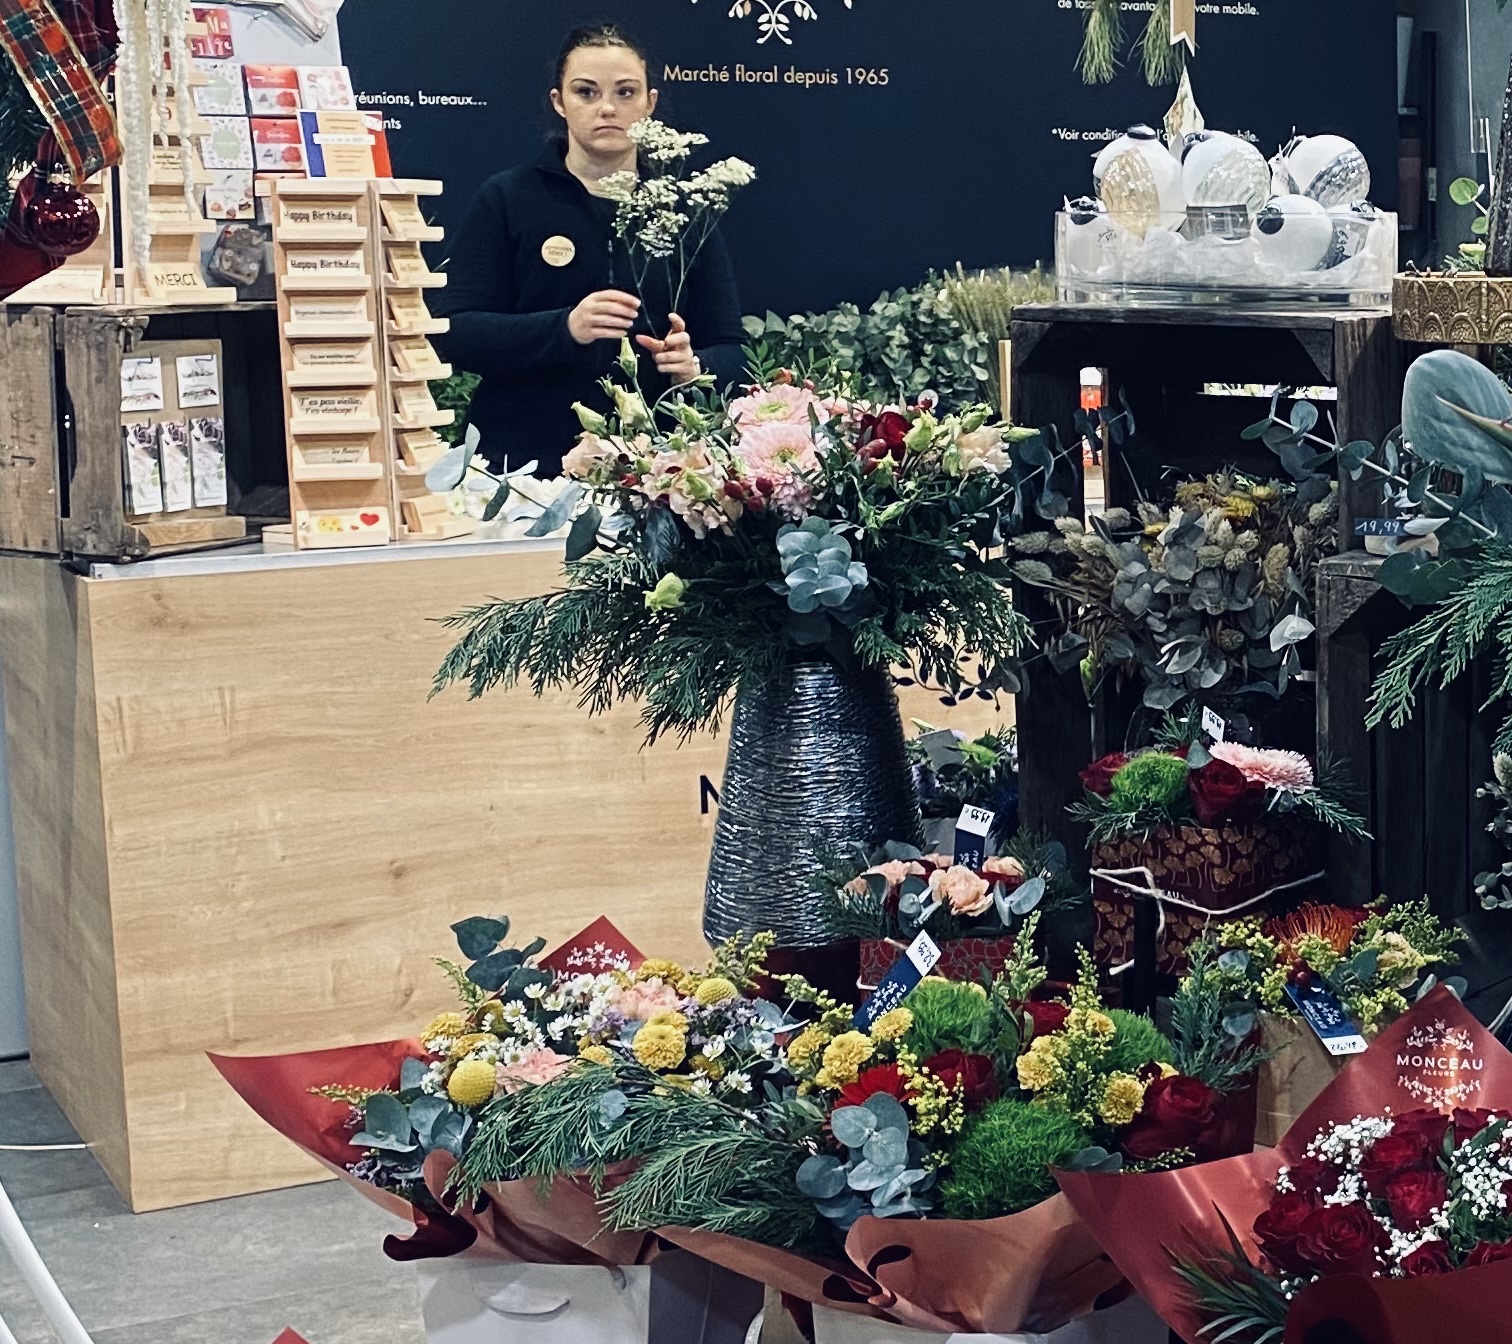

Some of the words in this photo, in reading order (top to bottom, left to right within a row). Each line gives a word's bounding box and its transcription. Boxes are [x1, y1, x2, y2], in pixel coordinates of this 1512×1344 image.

[1195, 3, 1220, 15] votre
[1222, 2, 1260, 16] mobile.
[663, 64, 730, 84] Marché
[735, 64, 779, 85] floral
[783, 66, 838, 88] depuis
[845, 67, 890, 87] 1965
[355, 91, 415, 108] réunions,
[418, 90, 488, 107] bureaux...
[283, 210, 310, 223] Happy
[312, 209, 353, 223] Birthday
[290, 259, 317, 271] Happy
[320, 258, 361, 271] Birthday
[154, 272, 198, 287] MERCI
[1355, 519, 1400, 535] 19,99
[1396, 1053, 1484, 1071] MONCEAU
